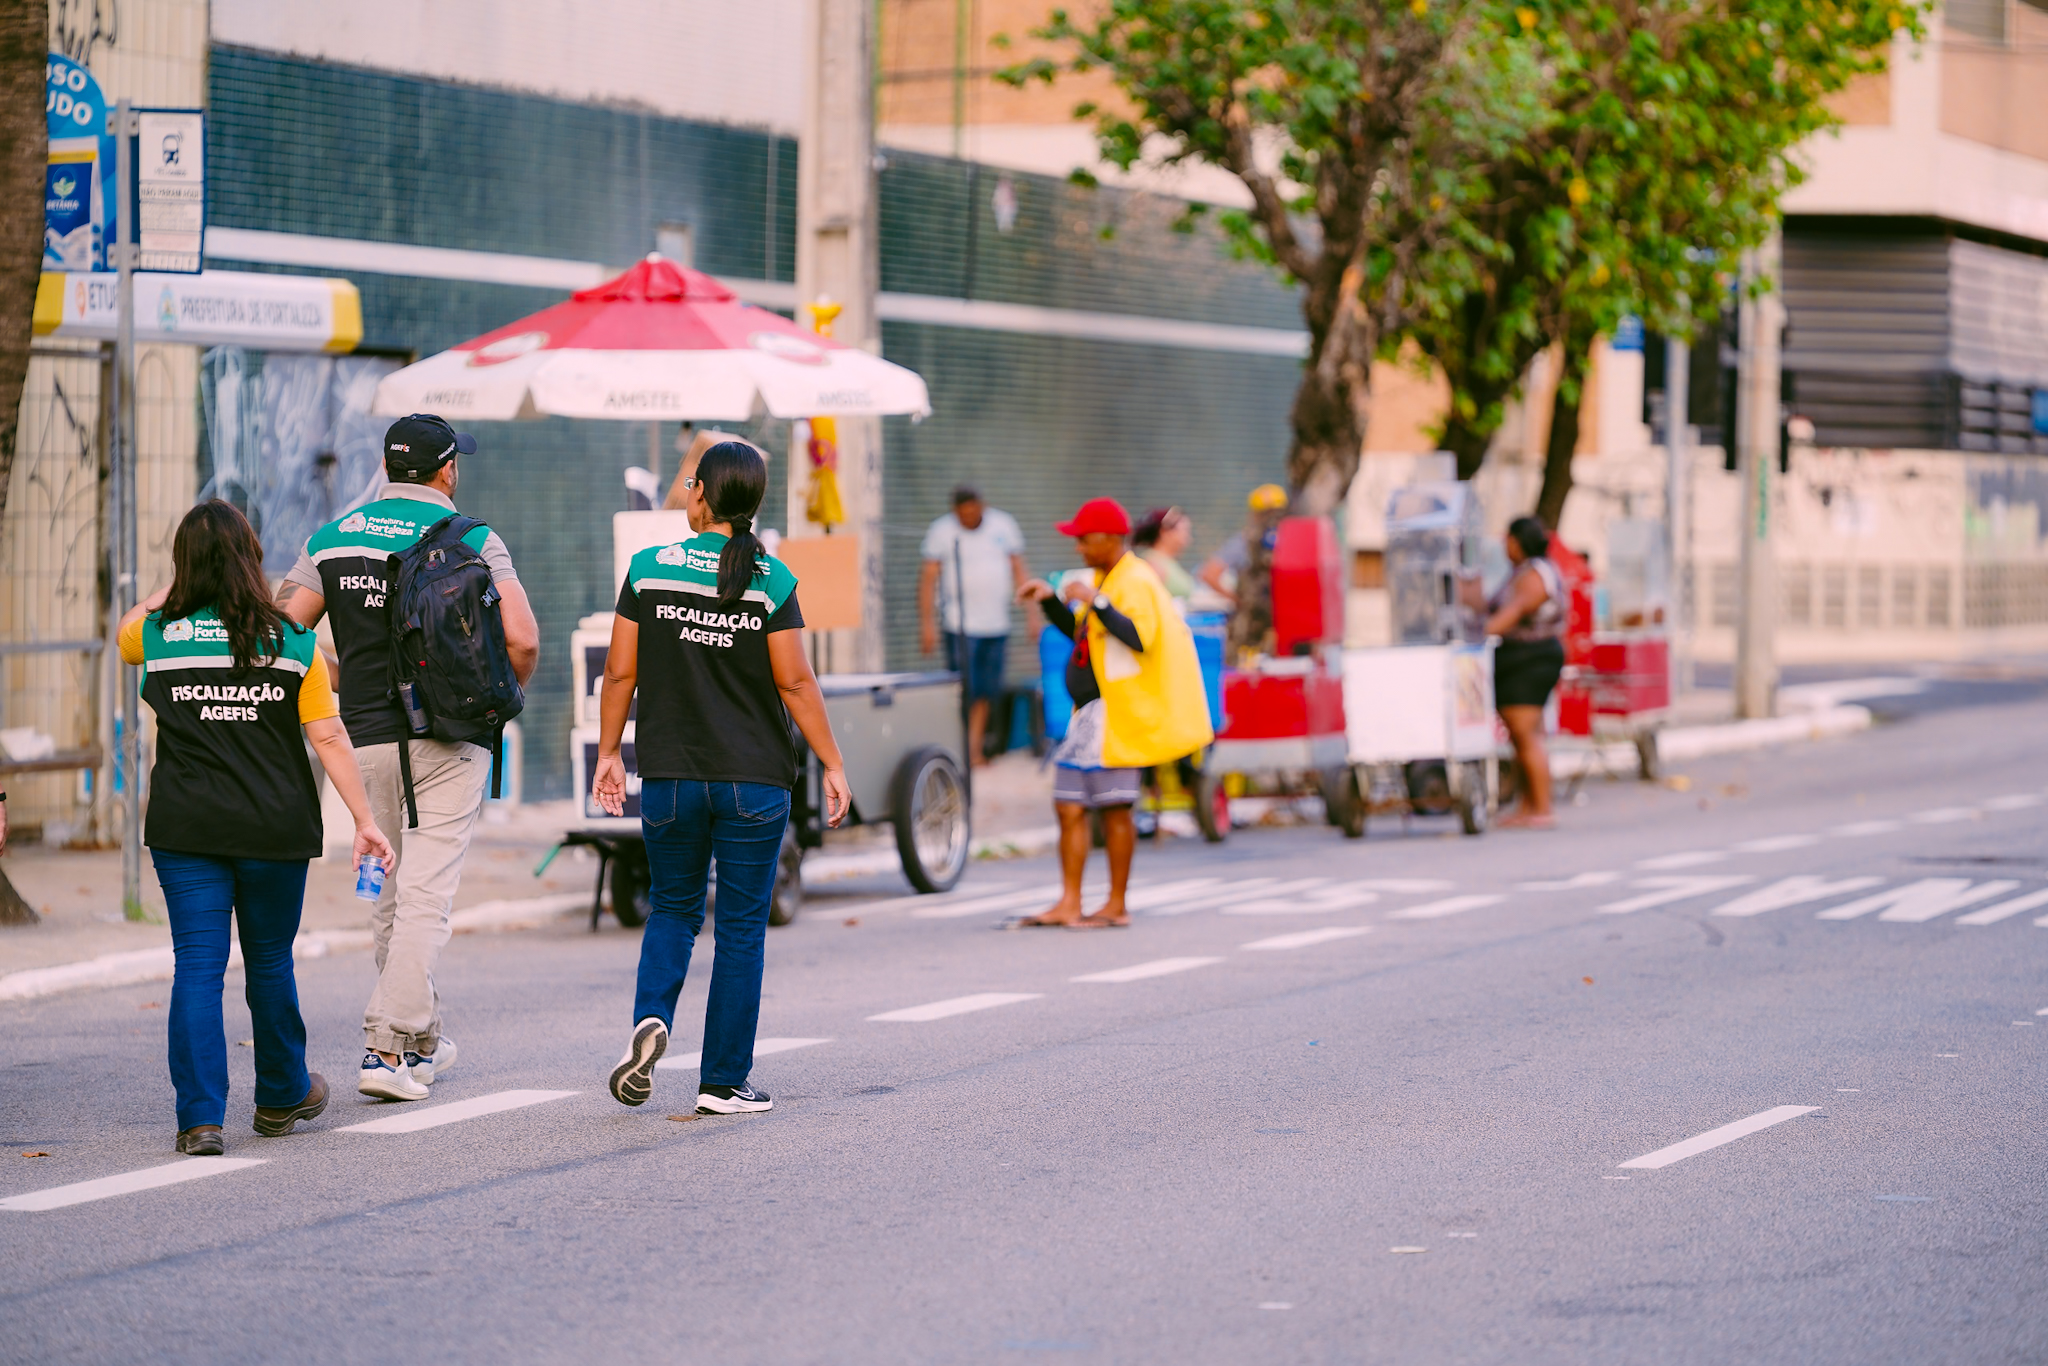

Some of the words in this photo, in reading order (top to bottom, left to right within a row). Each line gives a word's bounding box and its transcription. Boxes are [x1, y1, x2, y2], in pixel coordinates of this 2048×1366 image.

[181, 295, 246, 324] PREFEITURA
[262, 299, 321, 329] FORTALEZA
[421, 388, 475, 409] AMSTEL
[603, 389, 682, 411] AMSTEL
[365, 522, 414, 536] Fortaleza
[368, 516, 404, 527] Prefeitura
[405, 520, 416, 528] de
[656, 604, 763, 632] FISCALIZAÇÃO
[679, 626, 734, 648] AGEFIS
[171, 682, 285, 706] FISCALIZAÇÃO
[200, 705, 258, 721] AGEFIS
